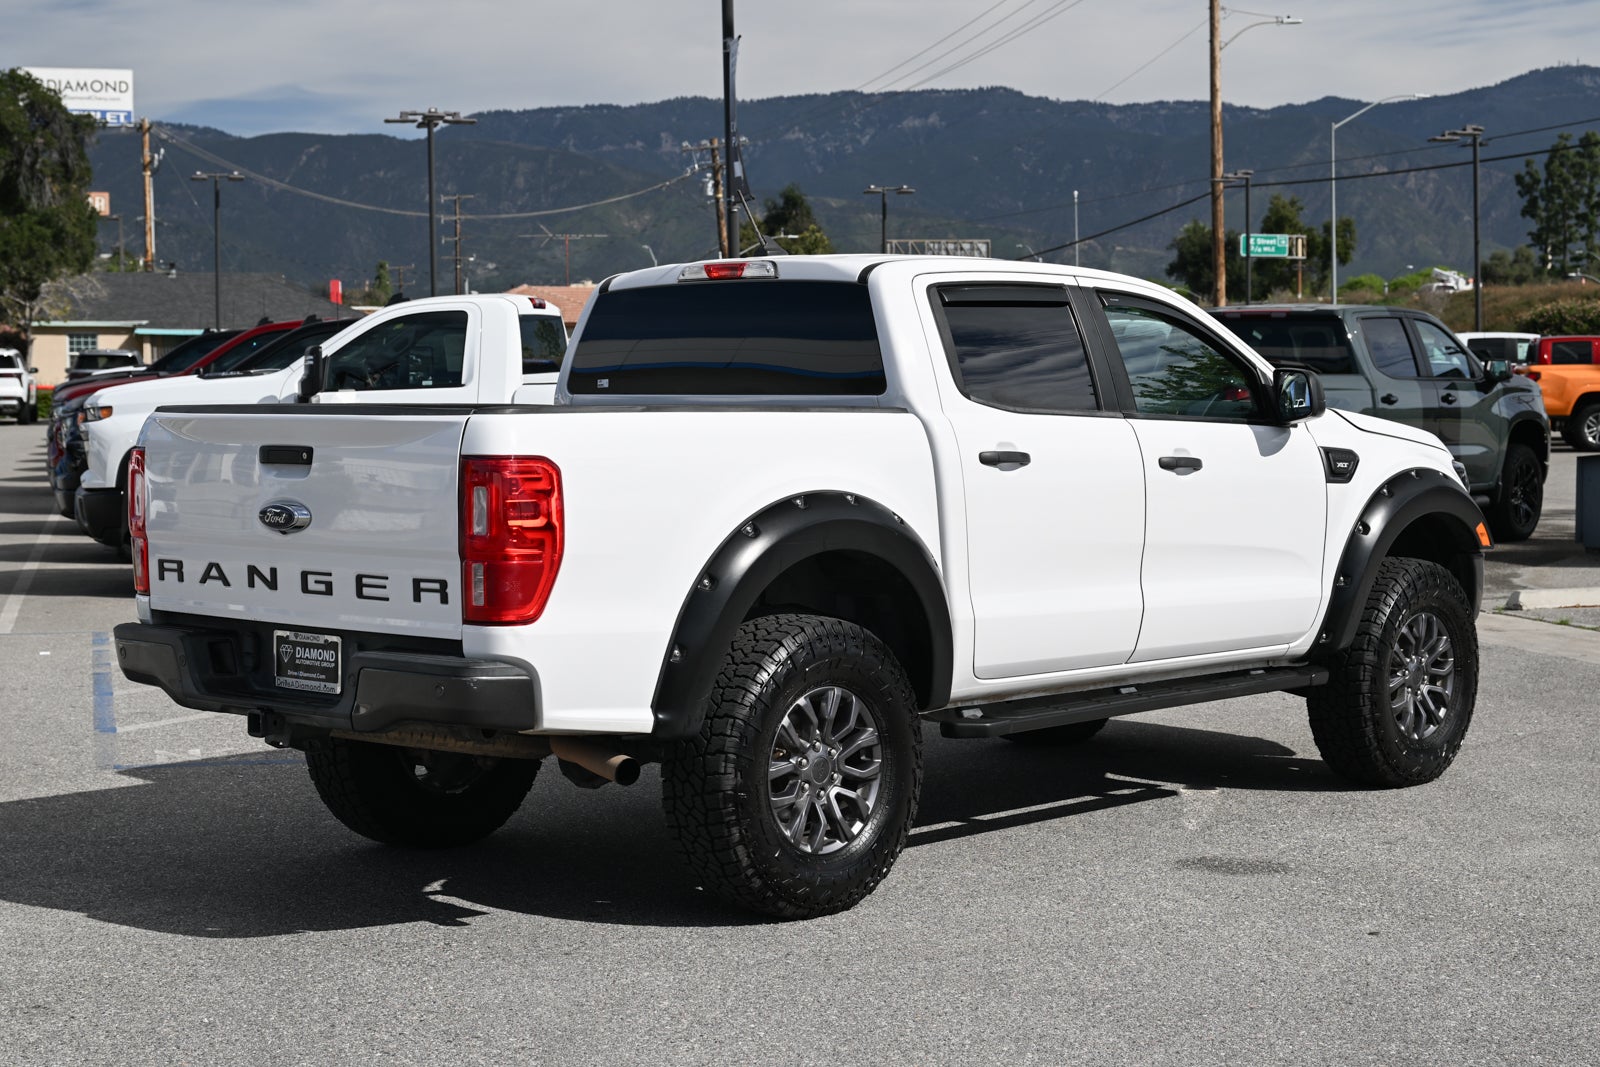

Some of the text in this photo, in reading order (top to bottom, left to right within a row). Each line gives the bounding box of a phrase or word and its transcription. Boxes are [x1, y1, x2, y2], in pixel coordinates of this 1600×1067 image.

[46, 79, 129, 94] DIAMOND
[265, 508, 286, 524] Ford
[158, 559, 449, 605] RANGER
[295, 647, 336, 661] DIAMOND
